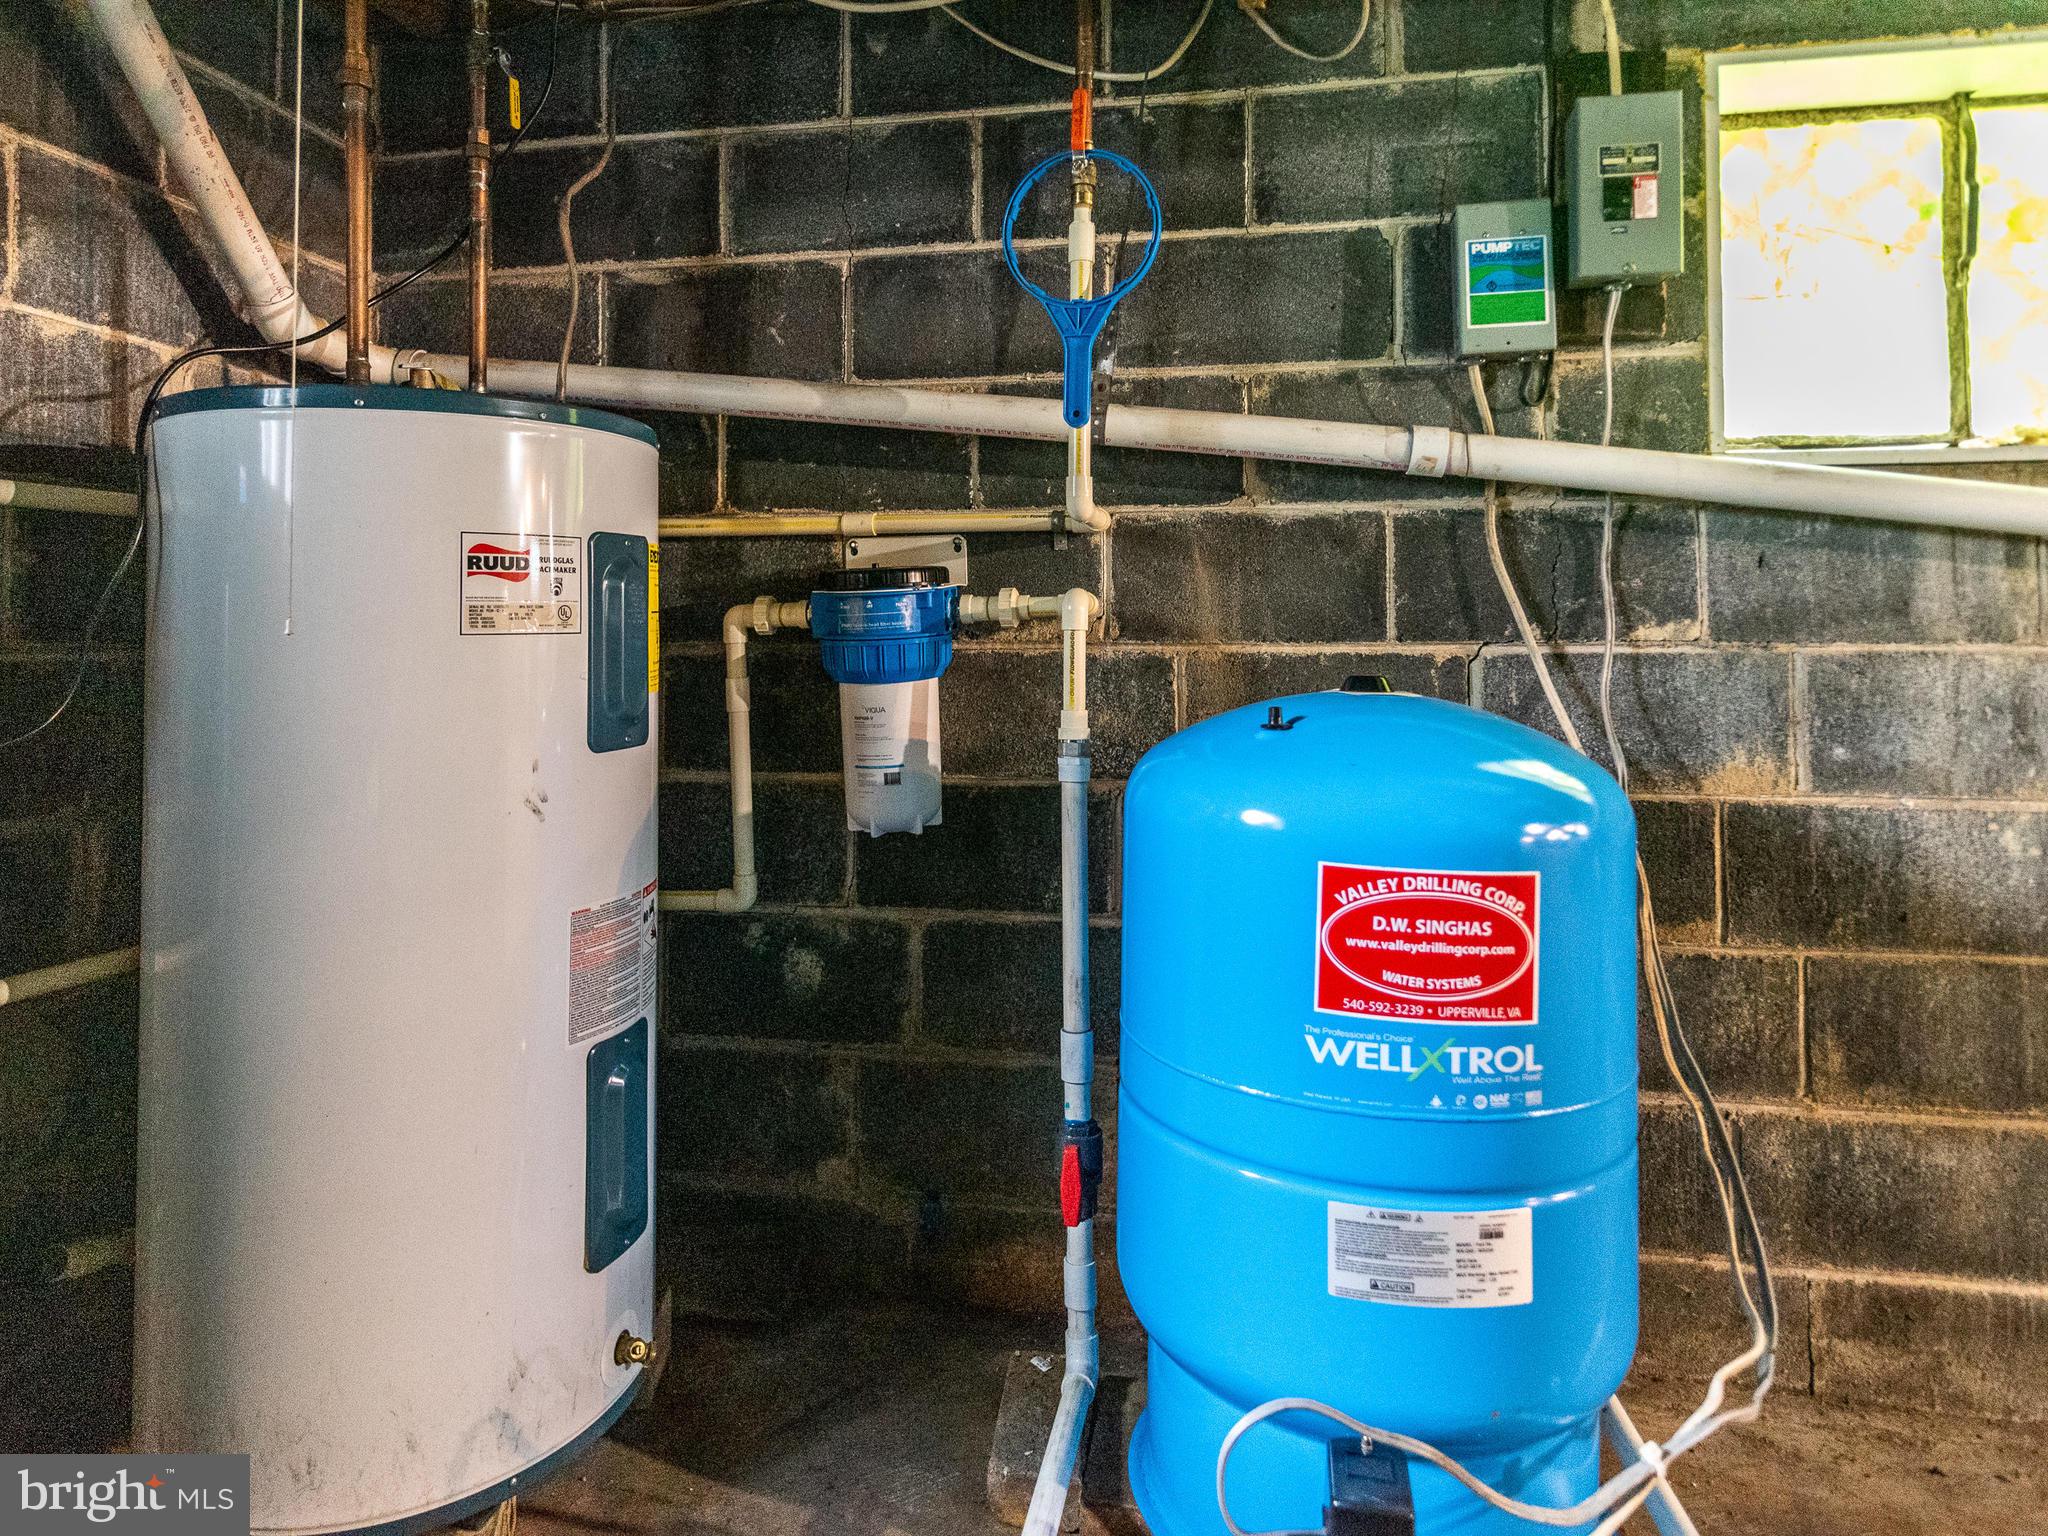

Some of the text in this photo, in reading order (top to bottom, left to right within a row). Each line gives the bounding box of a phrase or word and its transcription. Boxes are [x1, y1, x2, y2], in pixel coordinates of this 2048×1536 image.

[467, 555, 530, 570] RUUD
[538, 566, 577, 574] ACMAKER
[1334, 877, 1527, 917] VALLEY DRILLING CORP.
[1372, 916, 1493, 936] D.W. SINGHAS
[1345, 937, 1515, 957] www.valleydrillingcorp.com
[1382, 970, 1482, 990] WATER SYSTEMS
[1342, 998, 1424, 1016] 540-592-3239
[1304, 1024, 1321, 1034] The
[1322, 1027, 1382, 1041] Professional's
[1380, 1281, 1411, 1292] CAUTION
